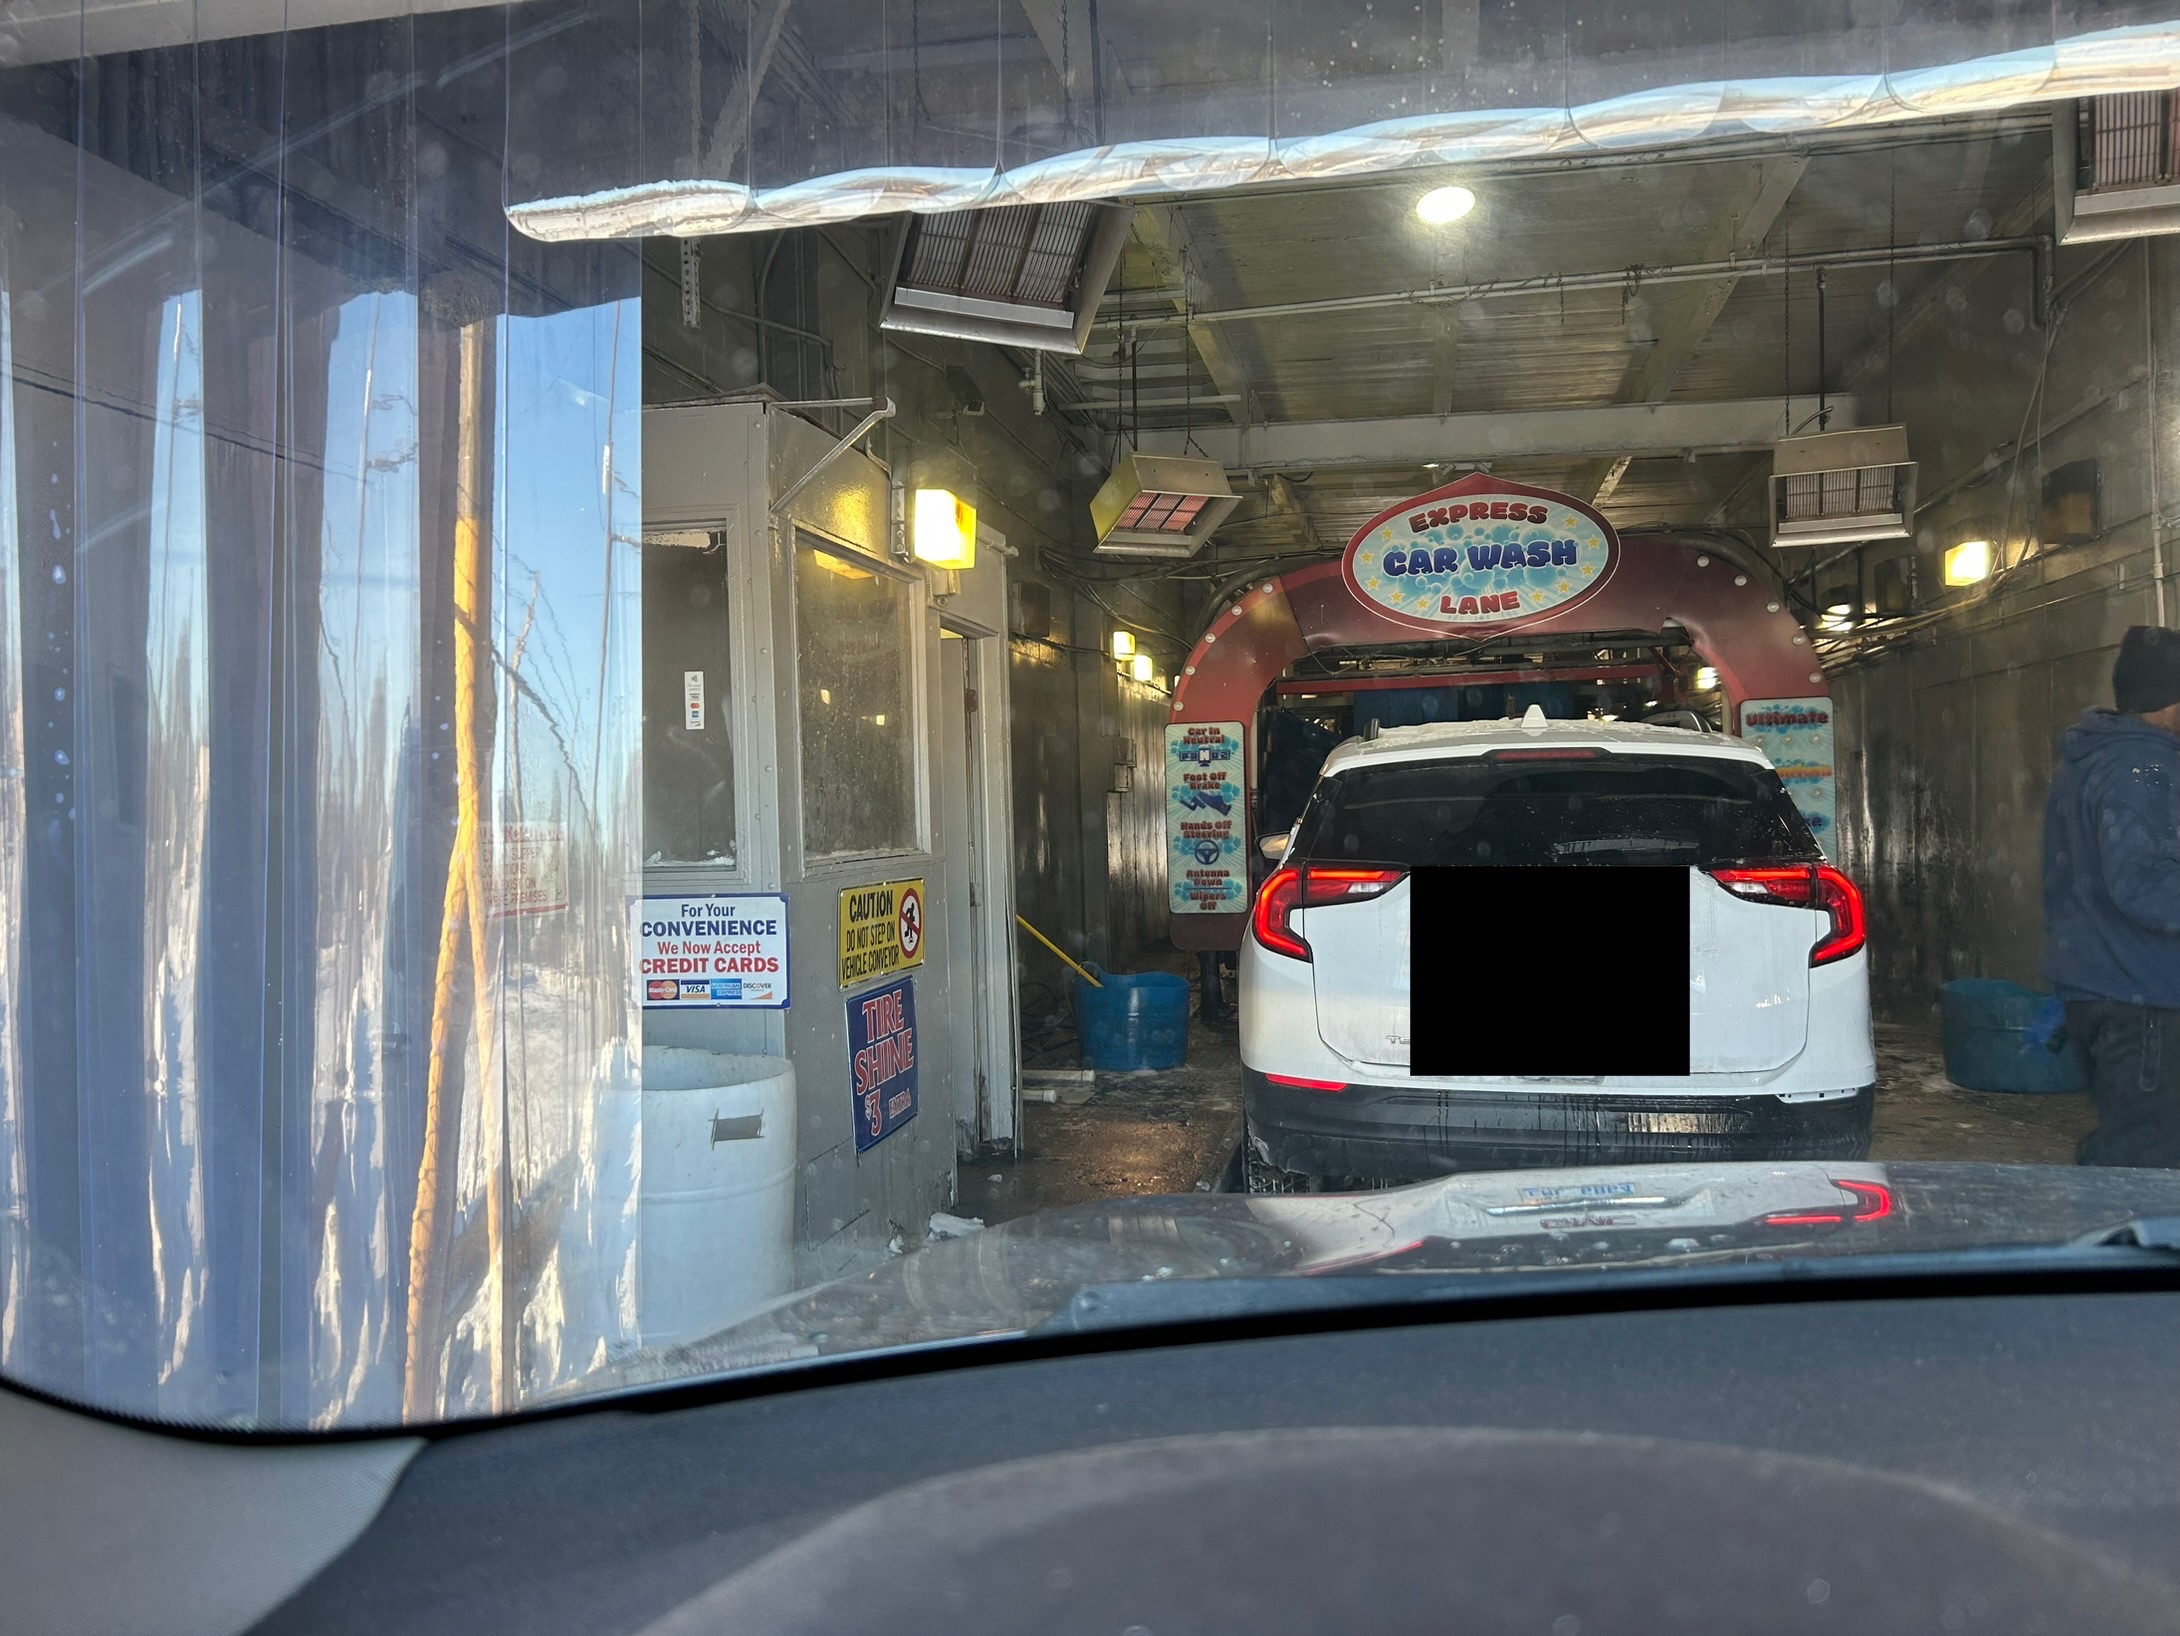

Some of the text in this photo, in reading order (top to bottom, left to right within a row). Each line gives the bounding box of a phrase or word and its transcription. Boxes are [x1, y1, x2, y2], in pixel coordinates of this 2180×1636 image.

[1408, 502, 1548, 533] EXPRESS
[1383, 539, 1579, 576] CAR WASH
[1440, 591, 1520, 614] LANE
[1745, 711, 1829, 727] Ultimate
[1187, 727, 1207, 735] Car
[1183, 735, 1225, 744] Neutral
[1183, 771, 1227, 781] Foot Off
[1190, 781, 1220, 790] Brake
[1181, 820, 1232, 830] Hands Off
[1183, 829, 1230, 839] Steering
[1186, 869, 1230, 877] Antenna
[1193, 878, 1223, 886] Down
[1190, 892, 1227, 901] Wipers
[681, 903, 735, 917] For Your
[849, 890, 893, 923] CAUTION
[1200, 901, 1217, 910] Off
[640, 920, 777, 937] CONVENIENCE
[847, 921, 895, 952] DO NOT STEP ON
[657, 940, 761, 956] We Now Accept
[640, 957, 779, 974] CREDIT CARDS
[842, 945, 899, 980] VEHICLE CONVEYOR
[686, 985, 706, 993] VISA
[862, 989, 904, 1043] TIRE
[854, 1028, 914, 1095] SHINE
[865, 1089, 882, 1136] $3
